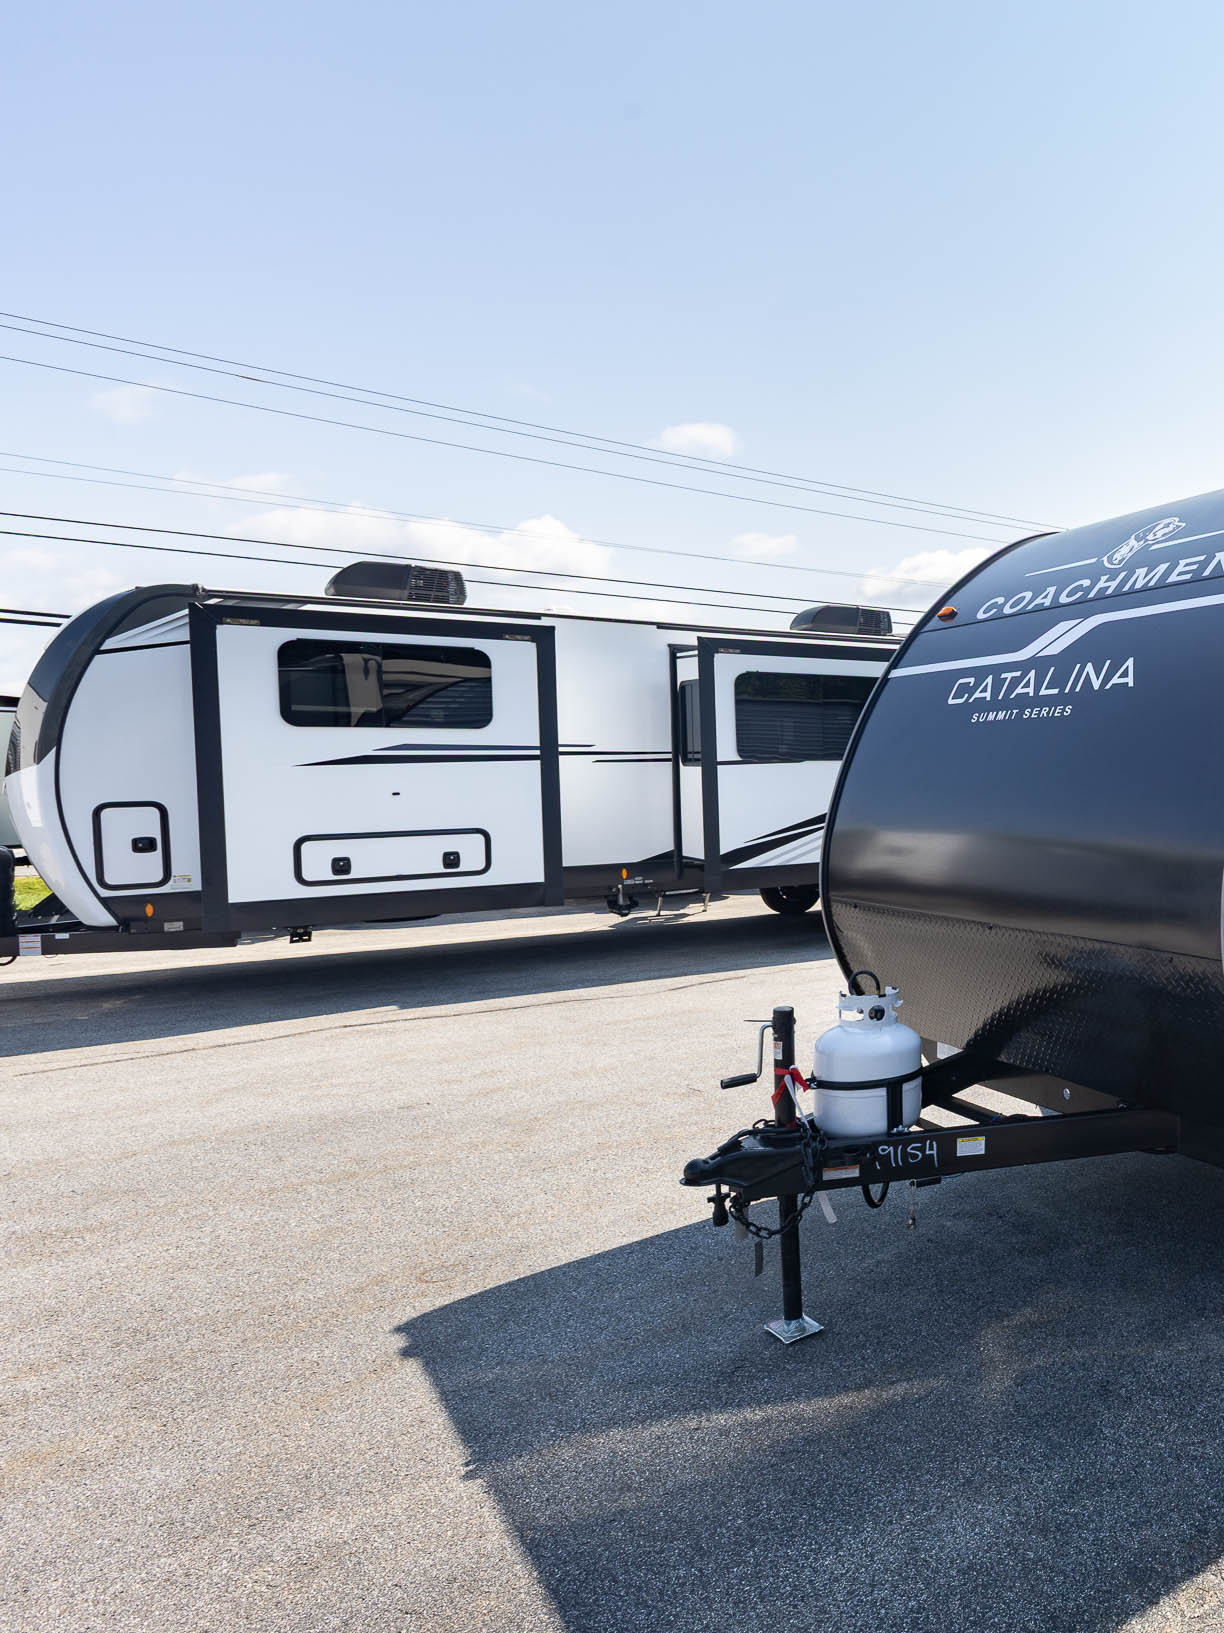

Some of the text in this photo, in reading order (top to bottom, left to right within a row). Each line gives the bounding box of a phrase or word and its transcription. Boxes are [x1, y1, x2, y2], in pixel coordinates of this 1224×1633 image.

[948, 657, 1134, 704] CATALINA
[971, 705, 1073, 722] SUMMIT SERIES
